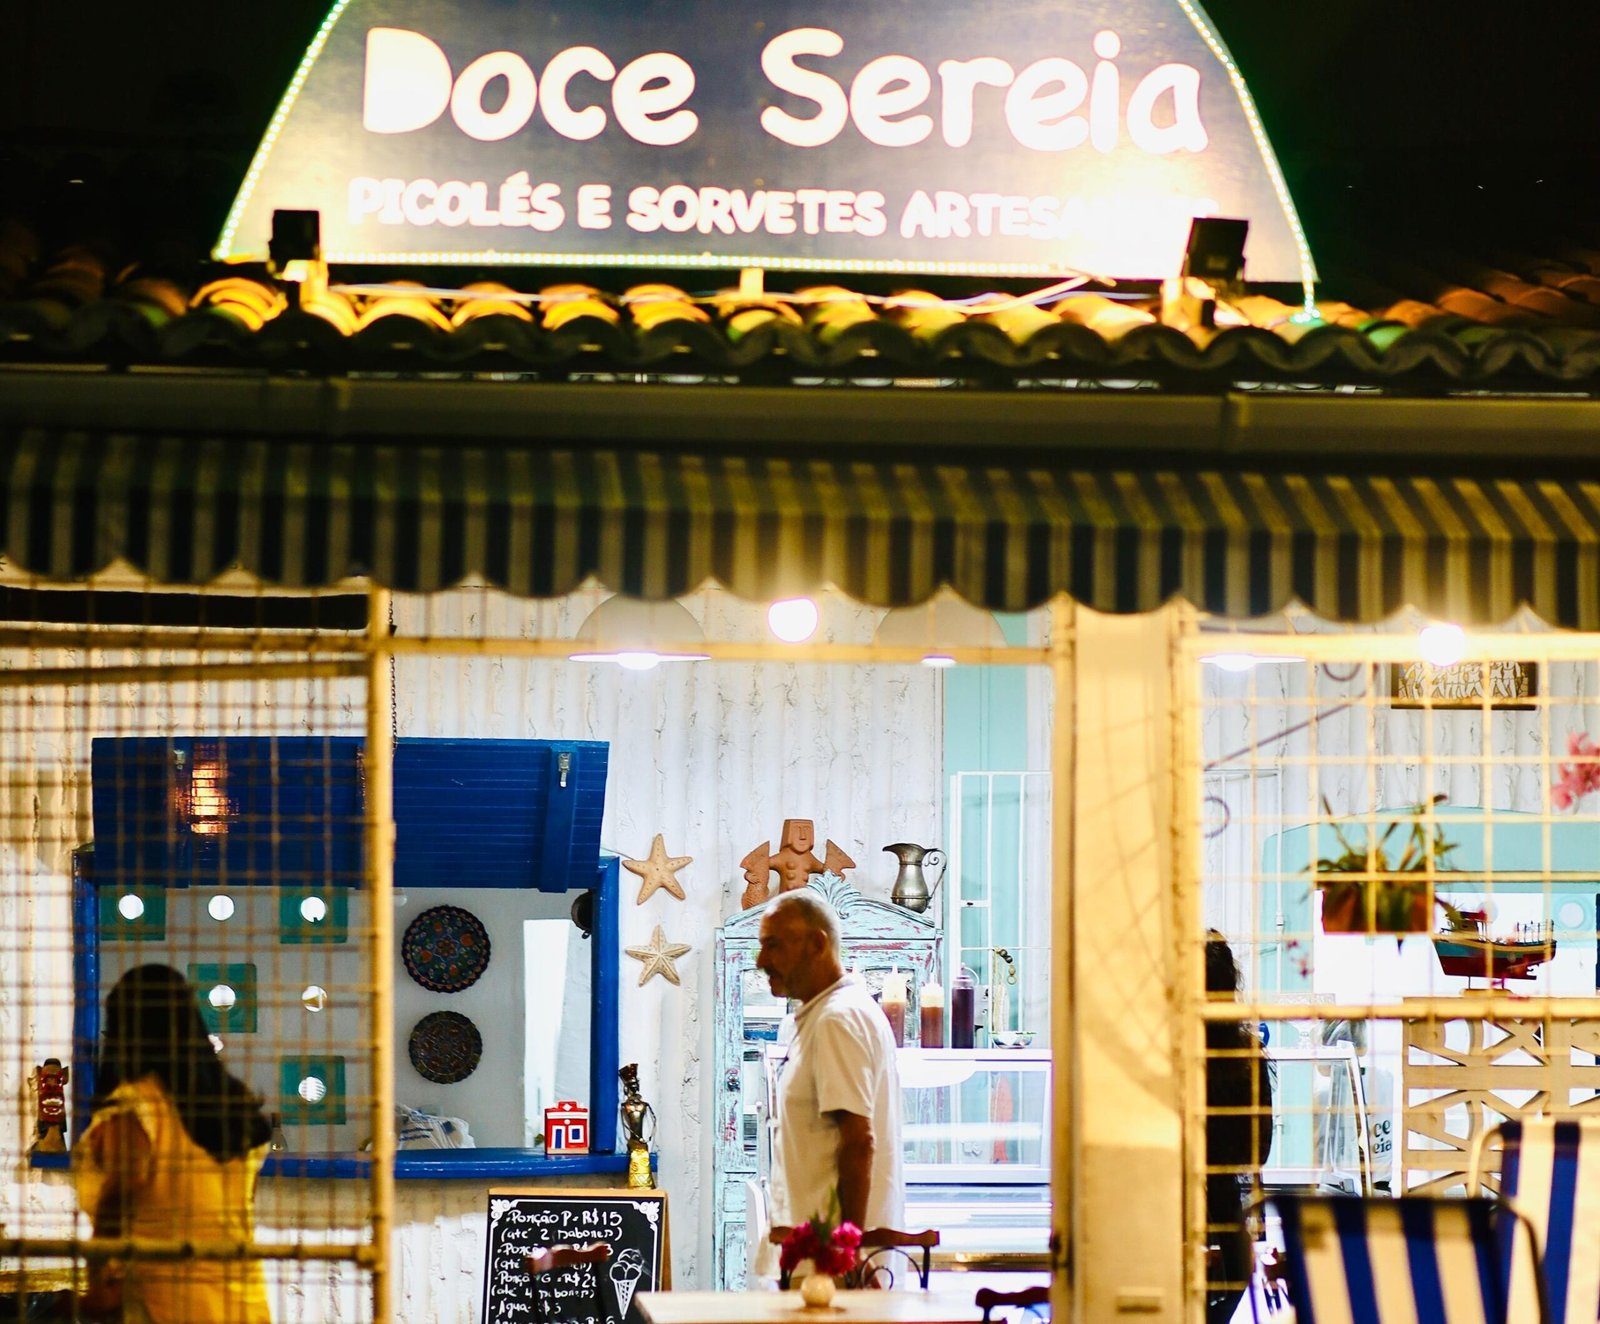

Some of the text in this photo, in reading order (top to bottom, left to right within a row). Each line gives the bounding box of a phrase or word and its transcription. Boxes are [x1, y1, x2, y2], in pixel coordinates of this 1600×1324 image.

[363, 26, 1209, 154] Doce Sereia
[348, 171, 565, 232] PICOLÉS
[577, 184, 612, 230] E
[627, 185, 887, 236] SORVETES
[501, 1227, 532, 1242] (até
[540, 1228, 550, 1241] 2
[494, 1256, 522, 1272] (até
[498, 1271, 533, 1287] Porçã
[541, 1273, 552, 1284] G
[491, 1284, 517, 1298] (até
